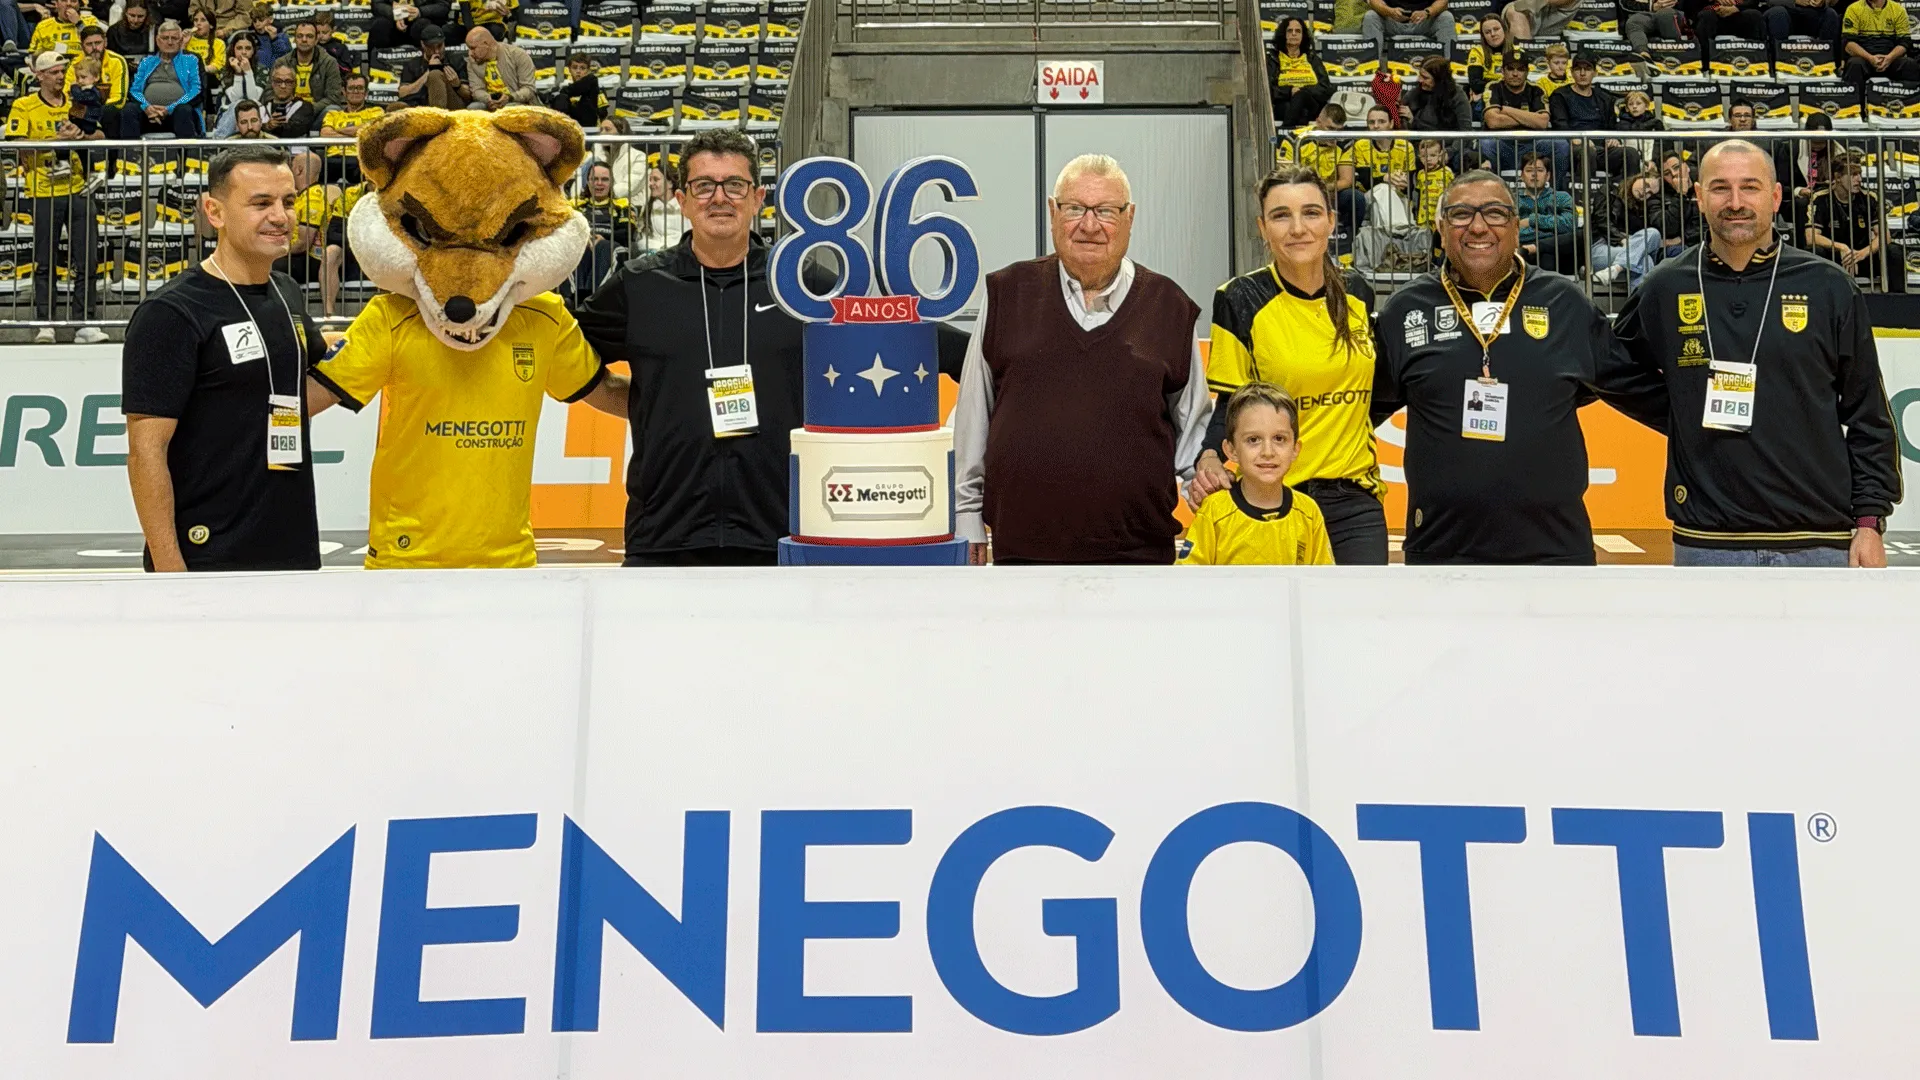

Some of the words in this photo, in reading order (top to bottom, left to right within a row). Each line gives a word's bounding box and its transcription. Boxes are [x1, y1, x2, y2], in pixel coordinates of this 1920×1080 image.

[646, 5, 691, 13] RESERVADO
[1327, 42, 1375, 50] RESERVADO
[1584, 43, 1633, 51] RESERVADO
[1042, 66, 1099, 86] SAIDA
[622, 89, 670, 98] RESERVADO
[1669, 86, 1717, 94] RESERVADO
[1736, 86, 1785, 95] RESERVADO
[768, 155, 982, 322] 86
[850, 301, 909, 319] ANOS
[425, 420, 527, 436] MENEGOTTI
[455, 436, 523, 449] CONSTRUÇÃO
[856, 486, 927, 504] Menegotti
[66, 801, 1819, 1044] MENEGOTTI
